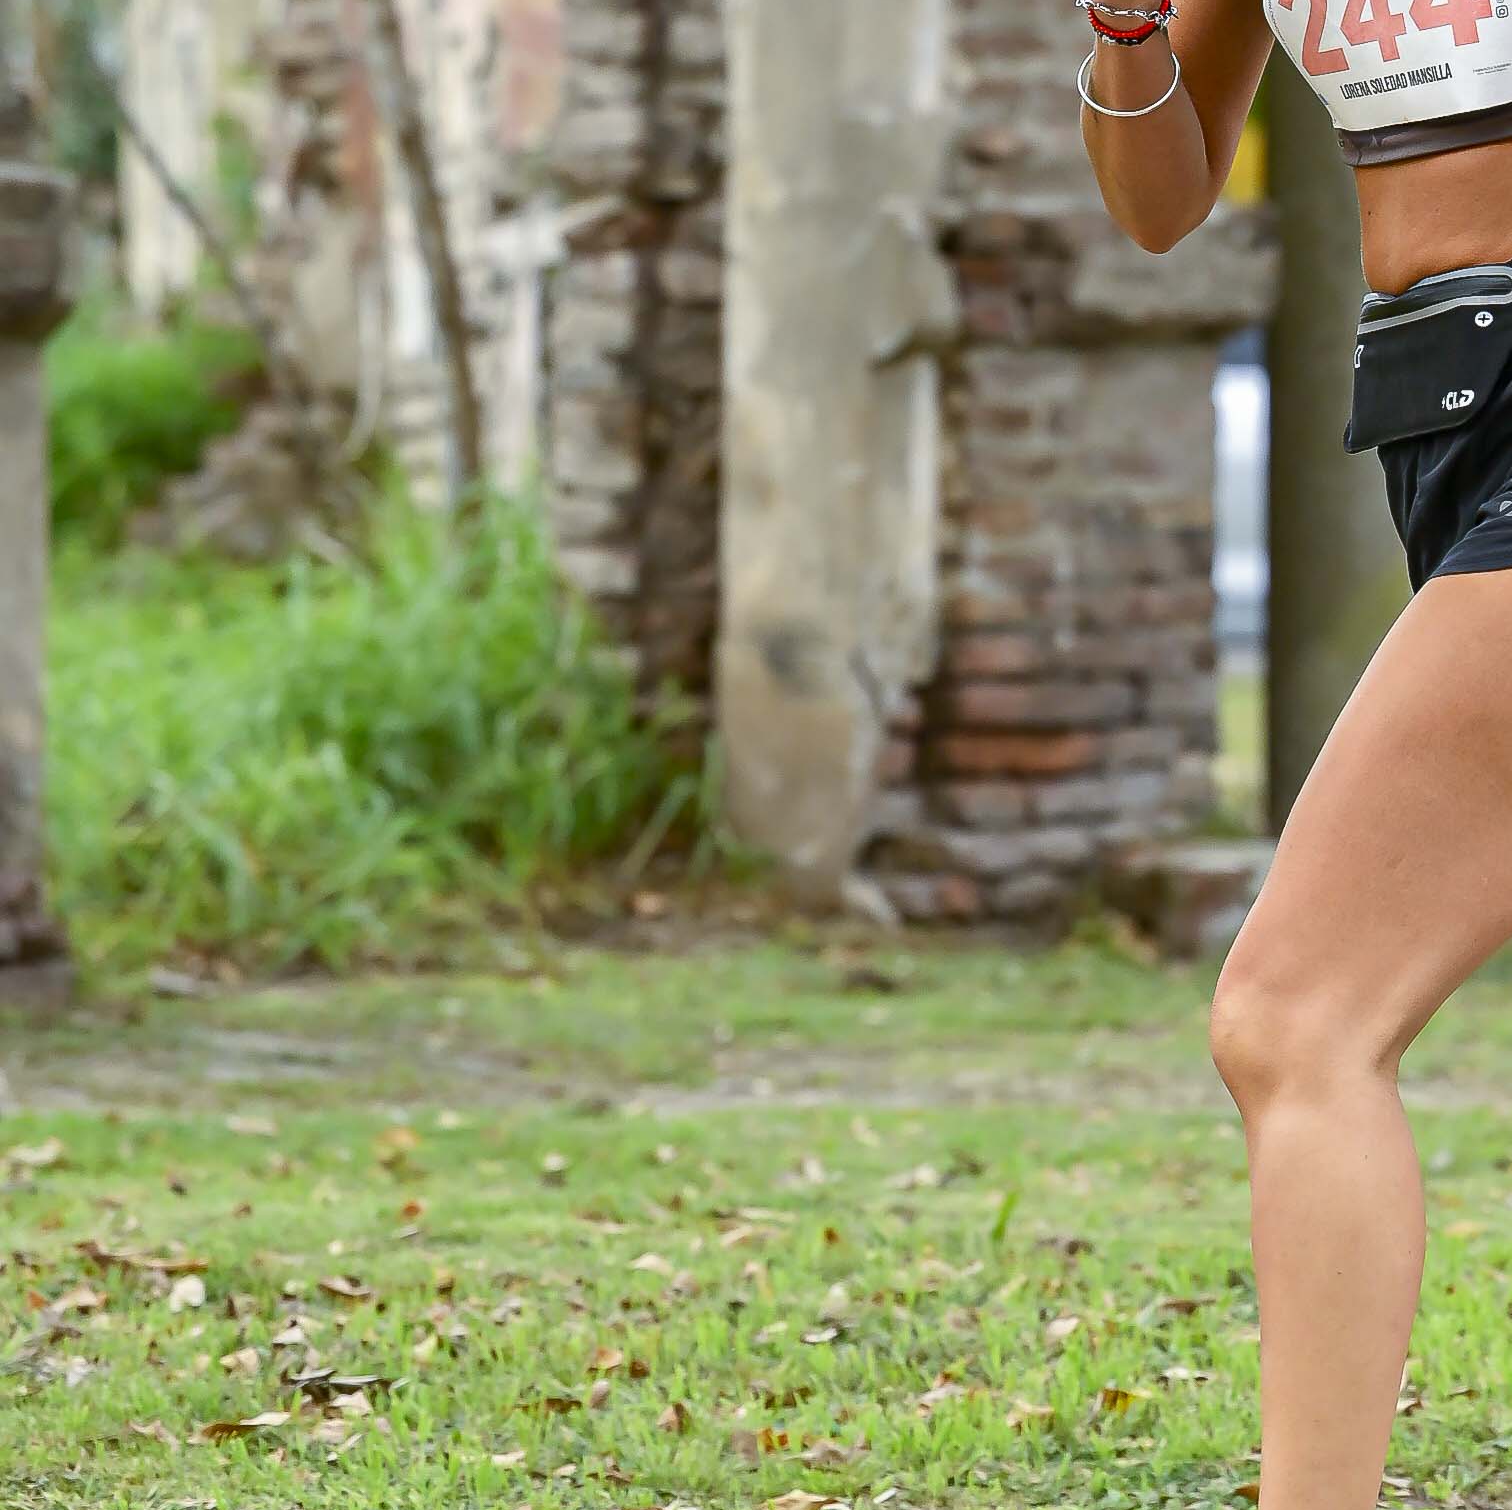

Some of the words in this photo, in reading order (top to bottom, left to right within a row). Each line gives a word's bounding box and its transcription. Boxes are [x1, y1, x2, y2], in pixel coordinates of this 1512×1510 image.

[1340, 80, 1373, 100] LORENA
[1370, 72, 1408, 96] SOLEDAD
[1407, 62, 1453, 87] MANSILLA
